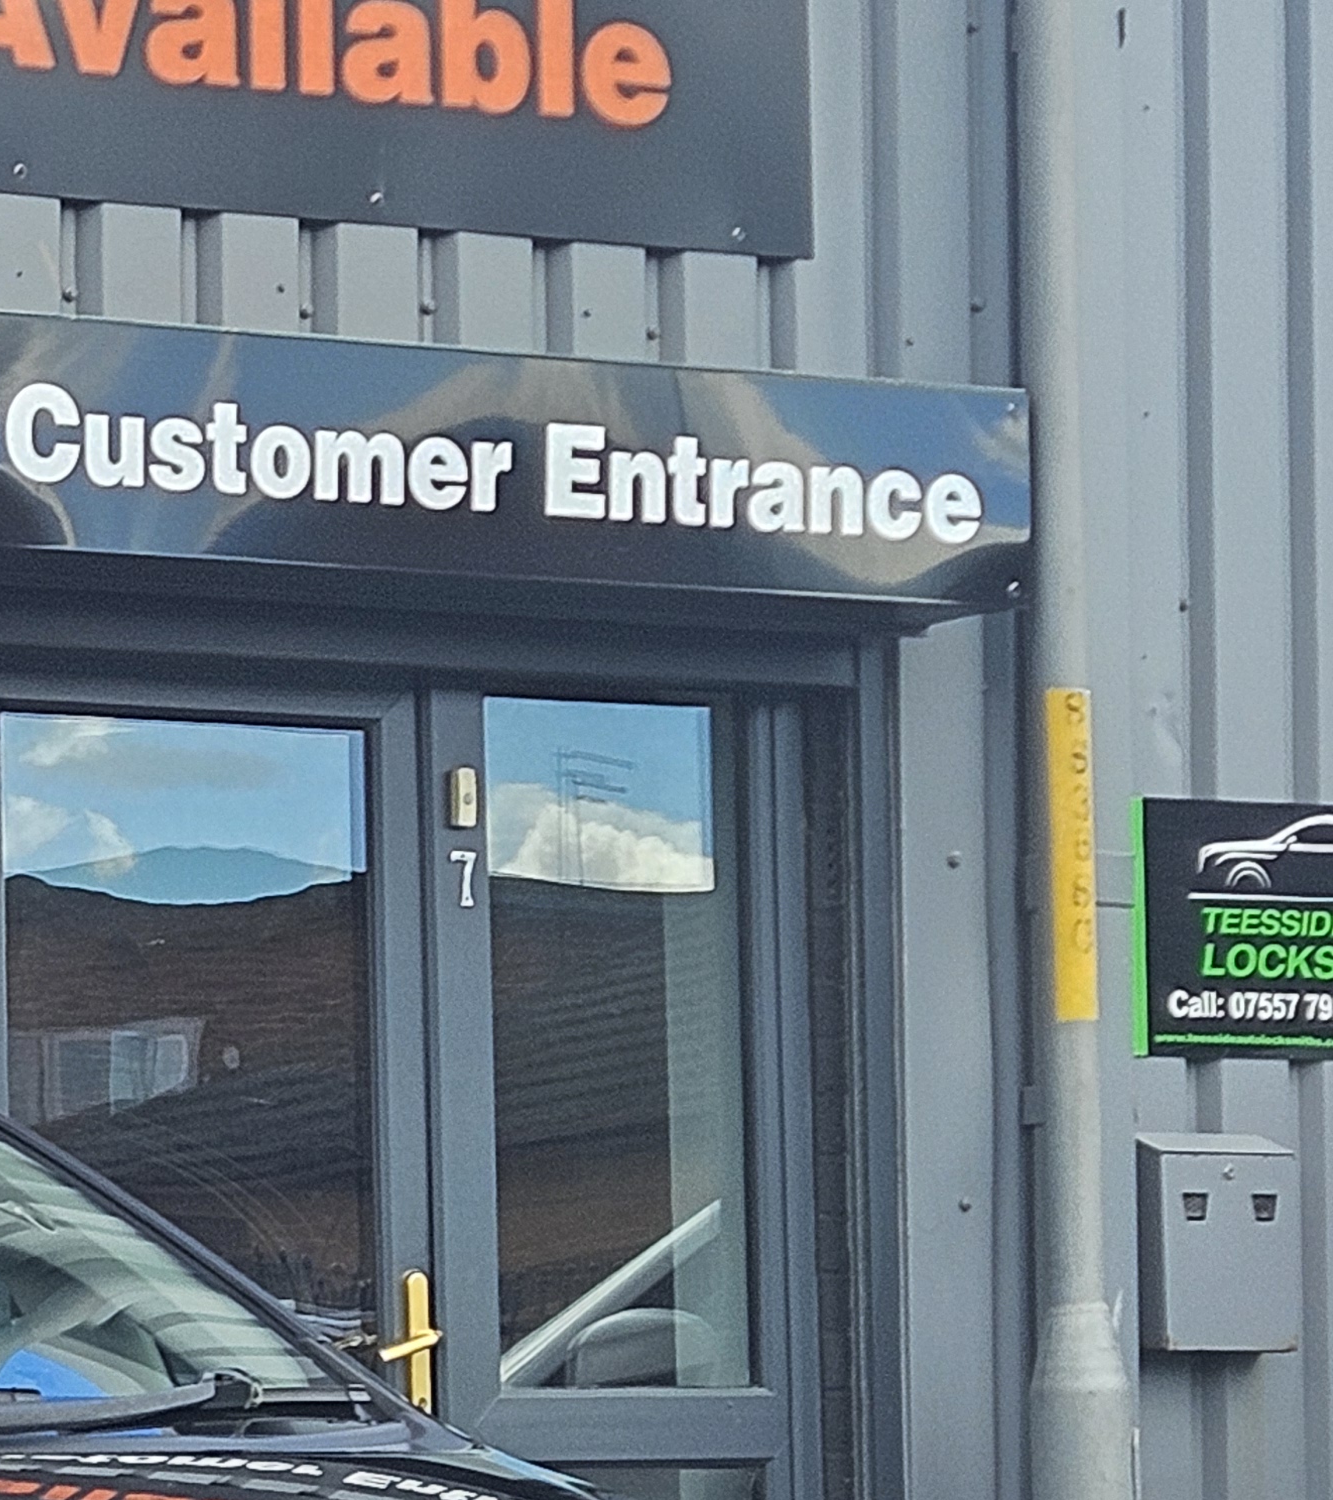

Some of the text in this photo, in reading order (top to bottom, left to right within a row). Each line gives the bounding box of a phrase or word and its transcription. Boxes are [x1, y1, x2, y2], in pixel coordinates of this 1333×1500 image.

[4, 383, 983, 544] Customer Entrance
[450, 851, 477, 907] 7
[1167, 989, 1225, 1018] Call:
[1228, 991, 1300, 1020] 07557
